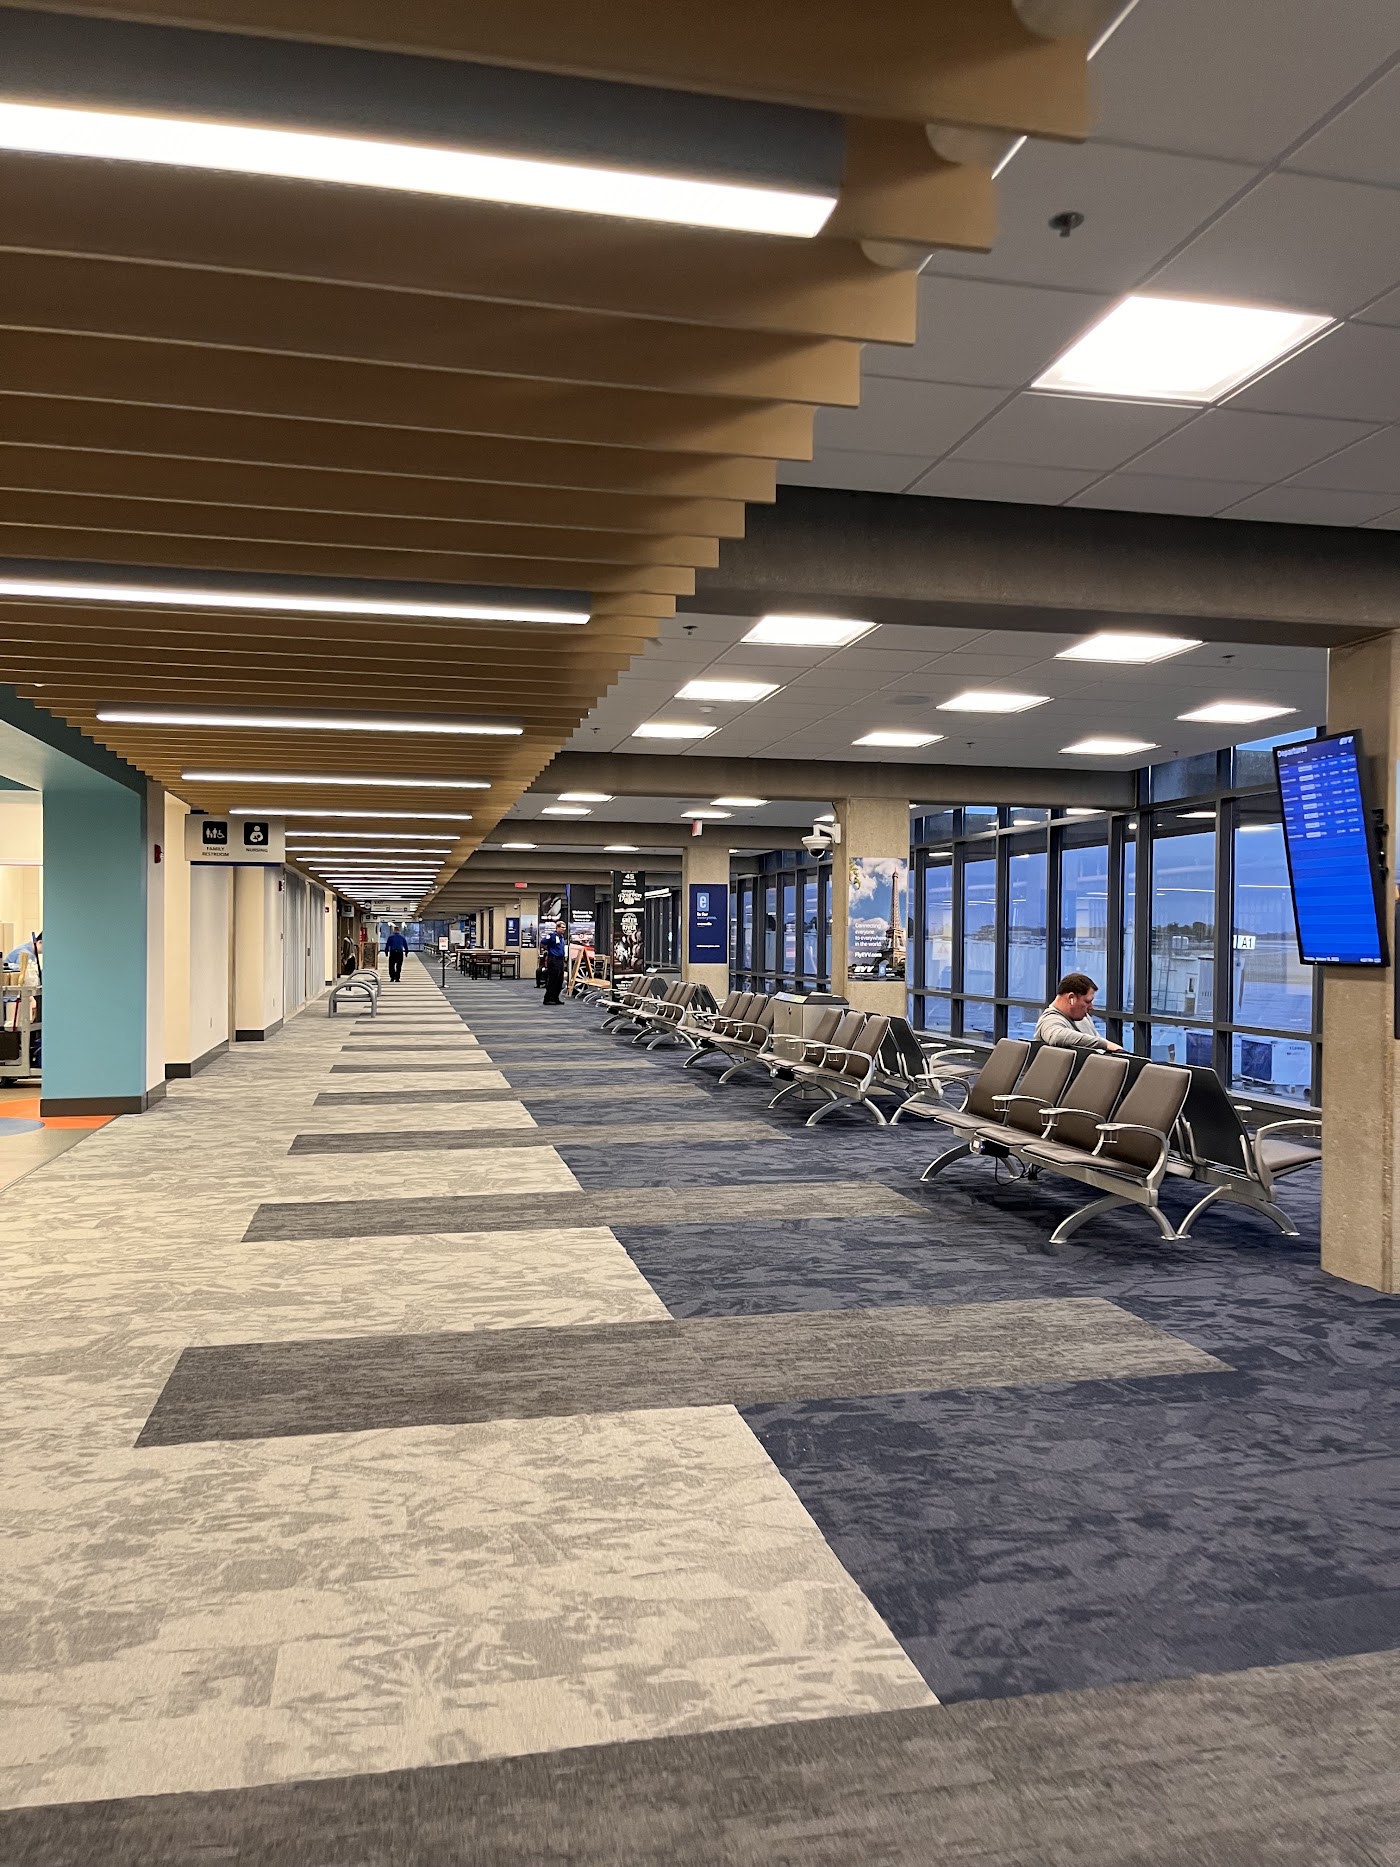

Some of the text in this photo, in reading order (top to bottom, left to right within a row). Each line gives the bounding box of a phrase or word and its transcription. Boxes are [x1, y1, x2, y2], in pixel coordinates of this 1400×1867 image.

[1277, 746, 1307, 757] Departures
[699, 896, 707, 909] e
[1242, 937, 1252, 948] A1
